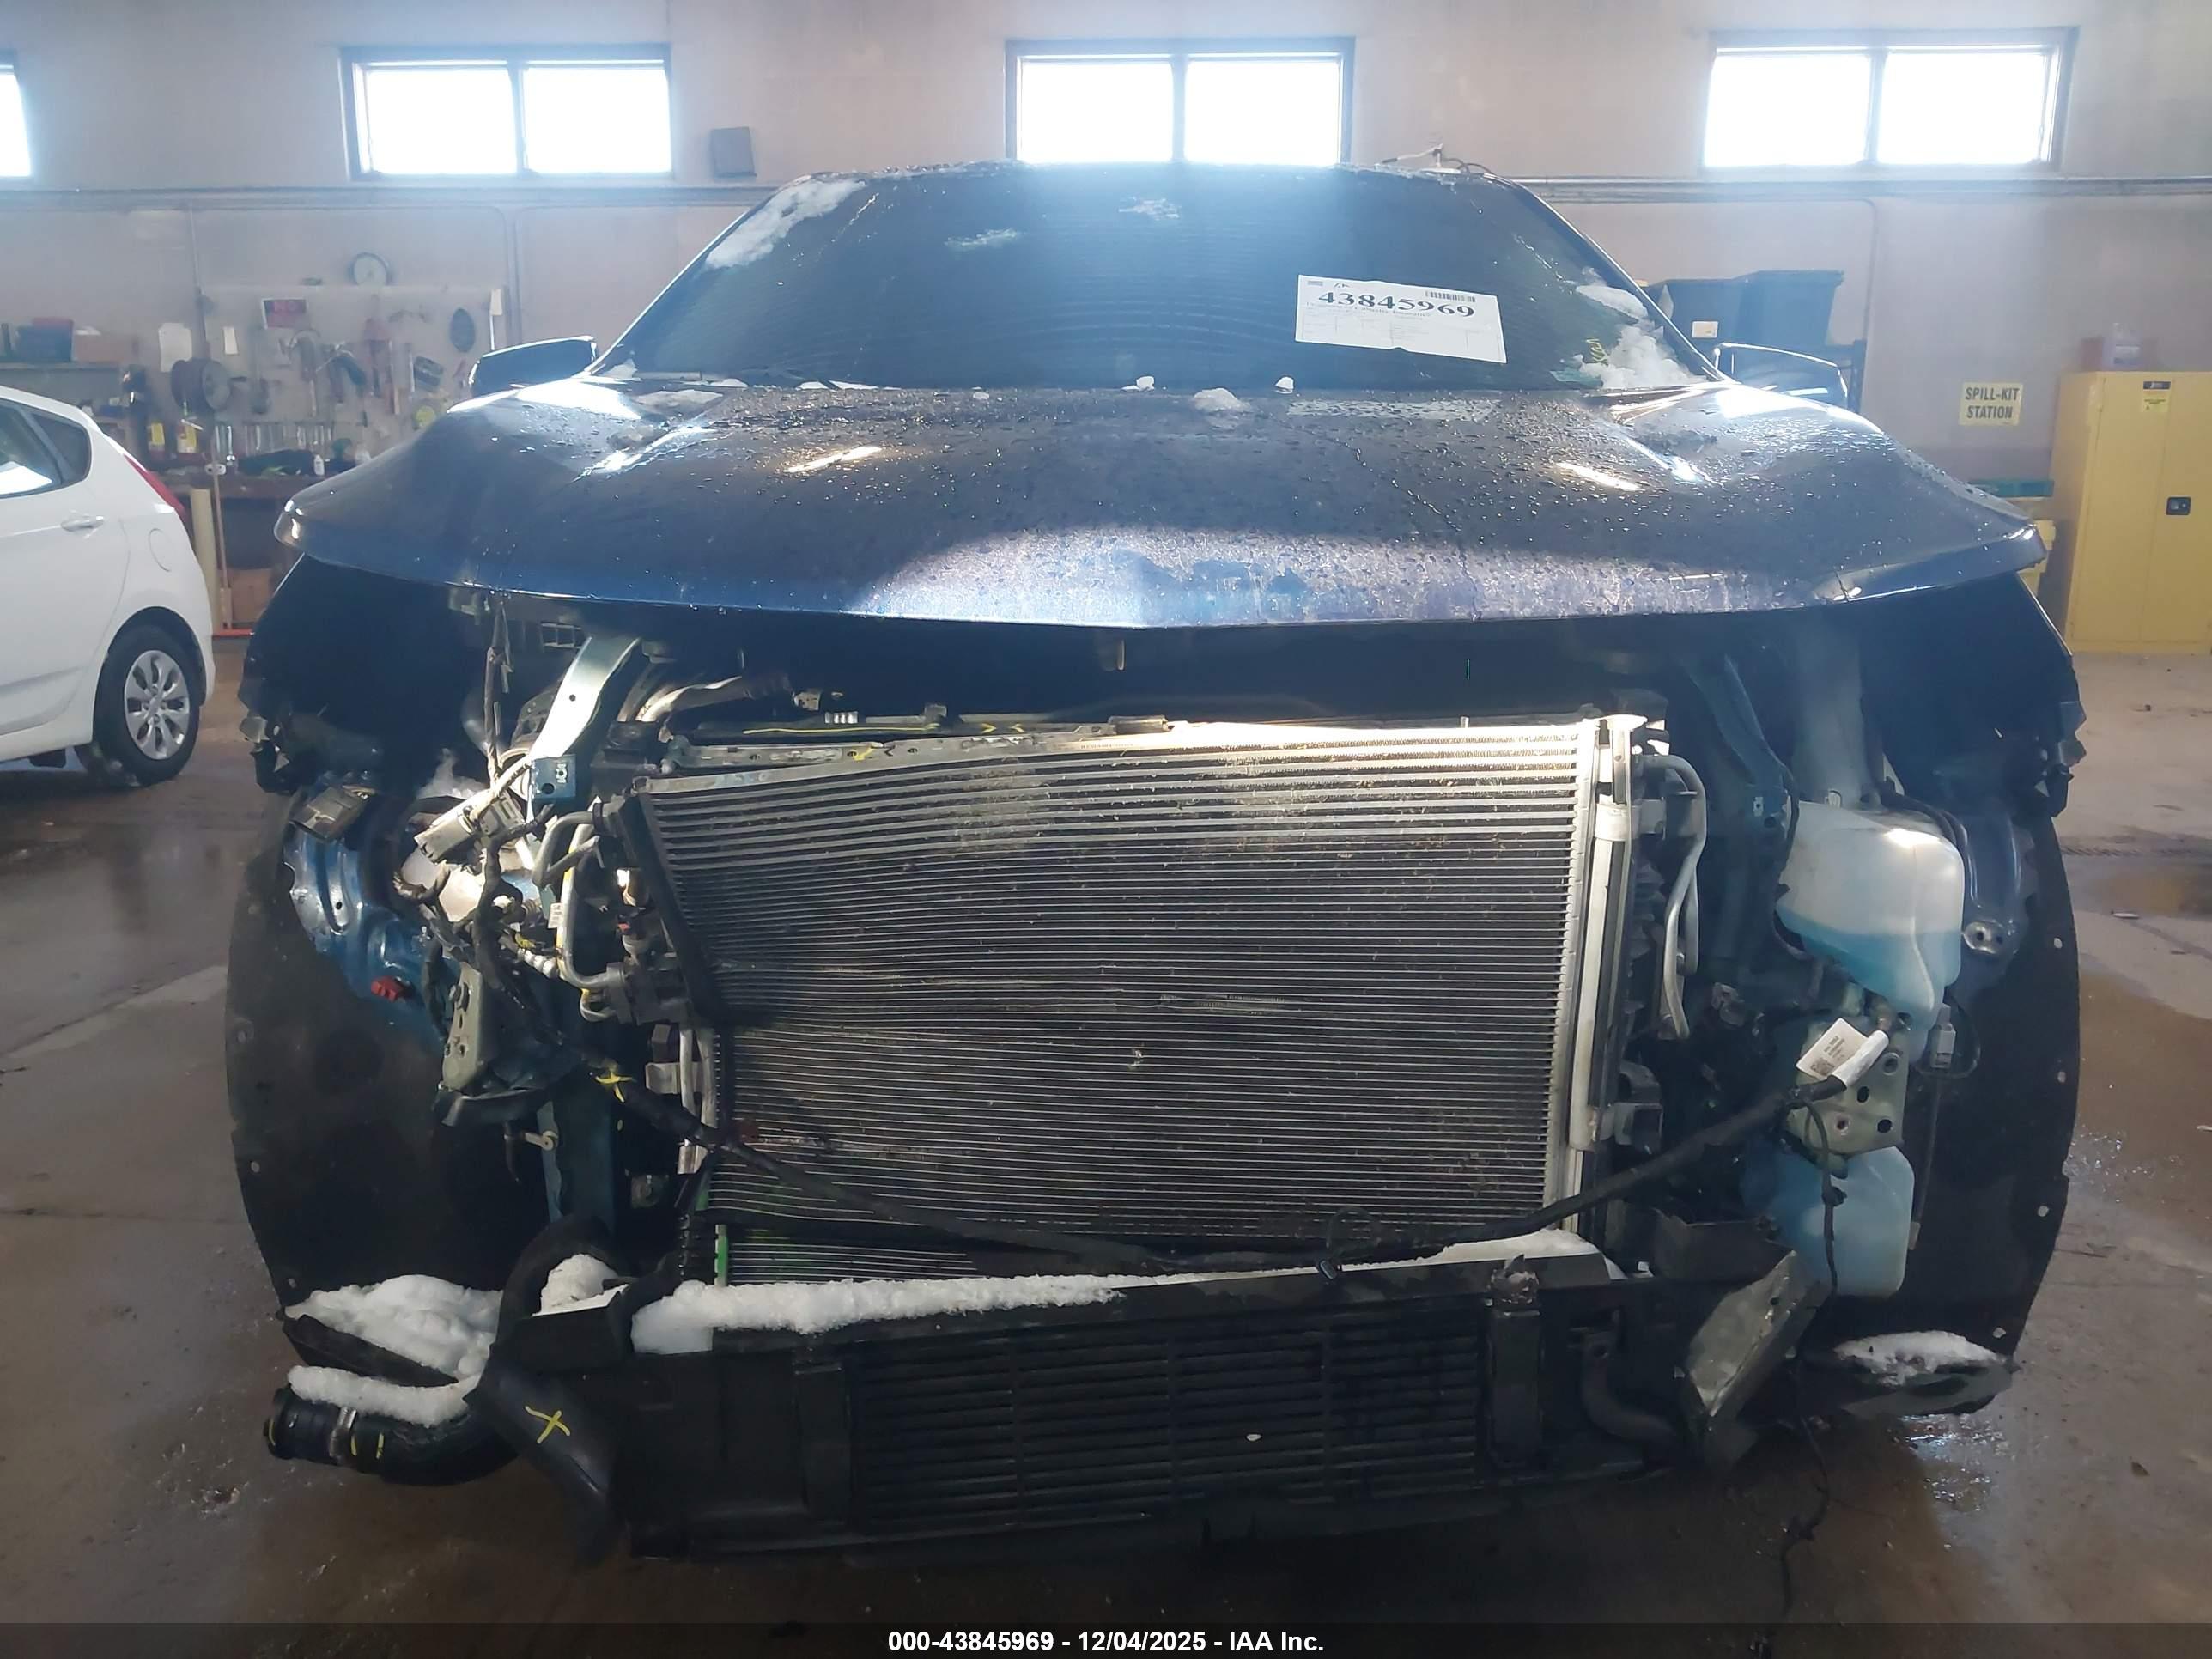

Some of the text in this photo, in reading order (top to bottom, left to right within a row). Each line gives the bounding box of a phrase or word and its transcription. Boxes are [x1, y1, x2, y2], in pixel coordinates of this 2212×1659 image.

[1318, 291, 1475, 317] 43845969
[1965, 386, 2021, 401] SPILL-KIT
[1966, 404, 2014, 419] STATION
